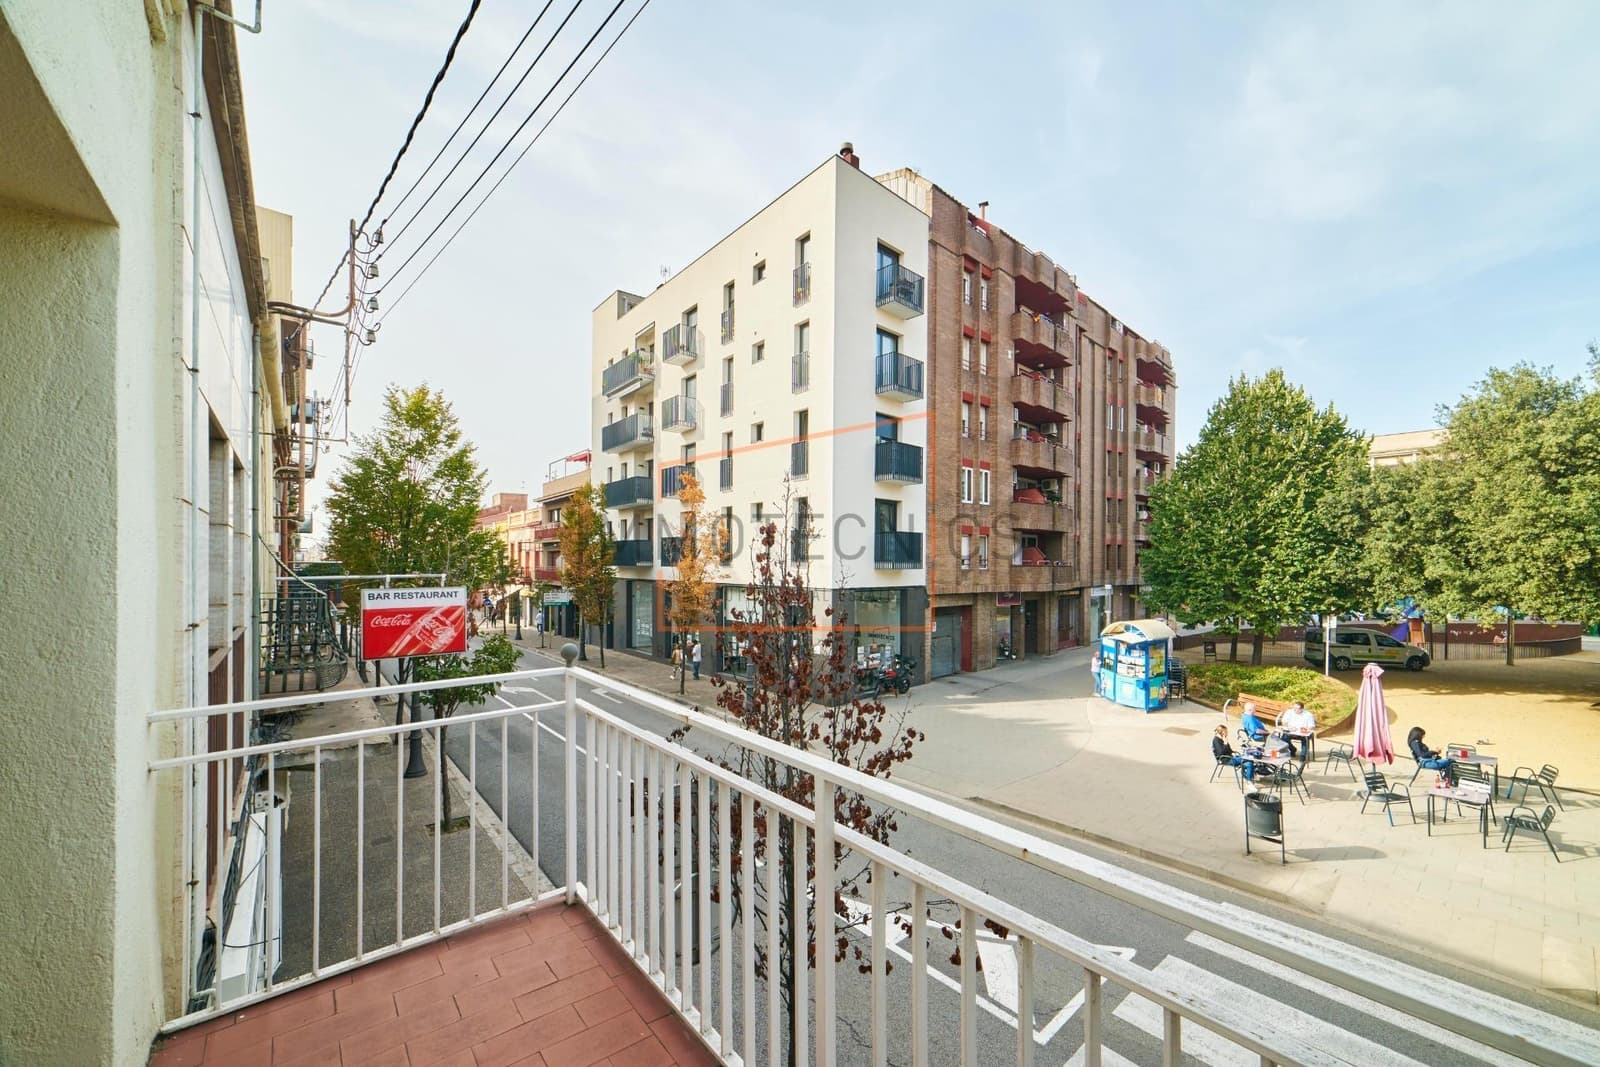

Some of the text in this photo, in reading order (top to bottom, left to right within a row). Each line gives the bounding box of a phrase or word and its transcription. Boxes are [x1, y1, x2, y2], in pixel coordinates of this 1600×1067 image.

[367, 590, 460, 601] BAR RESTAURANT
[370, 614, 413, 628] Coca-Cola
